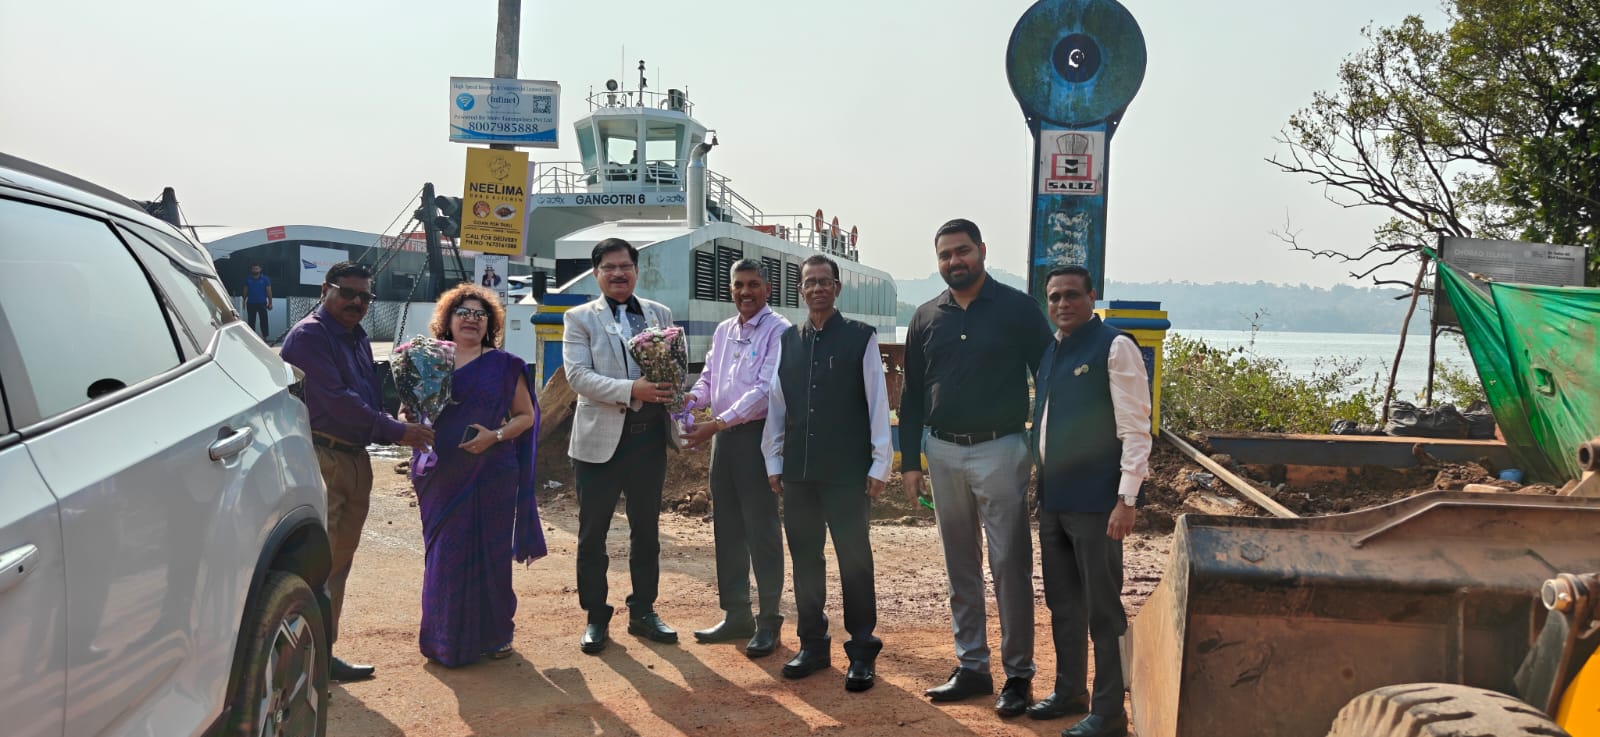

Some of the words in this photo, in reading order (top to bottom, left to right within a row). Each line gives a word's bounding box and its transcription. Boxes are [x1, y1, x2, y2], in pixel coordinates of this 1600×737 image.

[490, 96, 516, 104] Infinet
[468, 121, 539, 133] 8007985888
[469, 182, 524, 196] NEELIMA
[1048, 182, 1094, 190] SALIZ
[575, 194, 636, 205] GANGOTRI
[638, 194, 646, 204] 6
